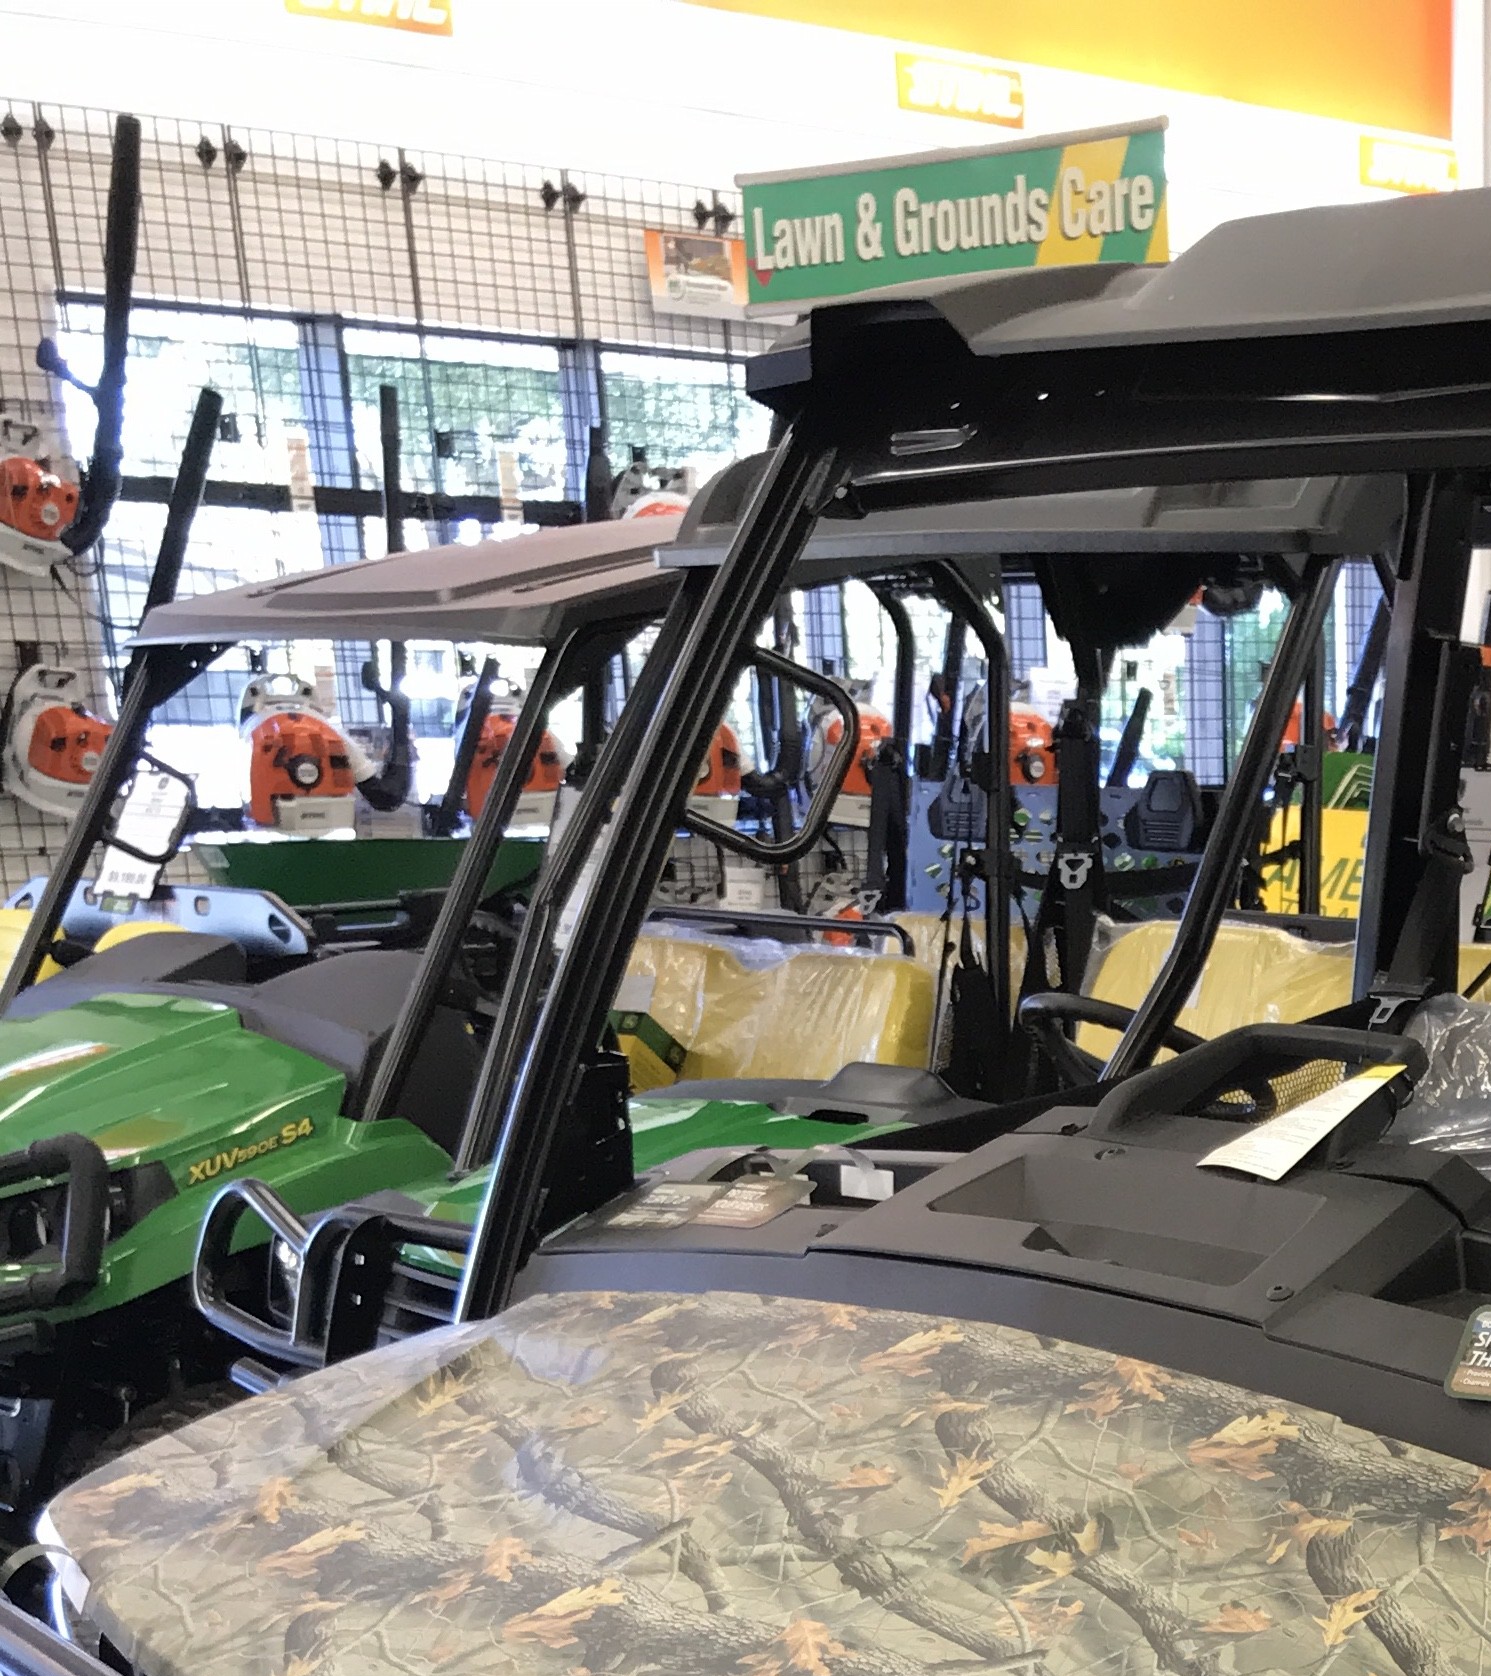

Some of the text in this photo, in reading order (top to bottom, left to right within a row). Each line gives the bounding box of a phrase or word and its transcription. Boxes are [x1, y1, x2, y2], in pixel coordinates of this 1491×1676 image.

[752, 166, 1156, 271] Lawn & Grounds Care
[281, 1118, 313, 1144] S4
